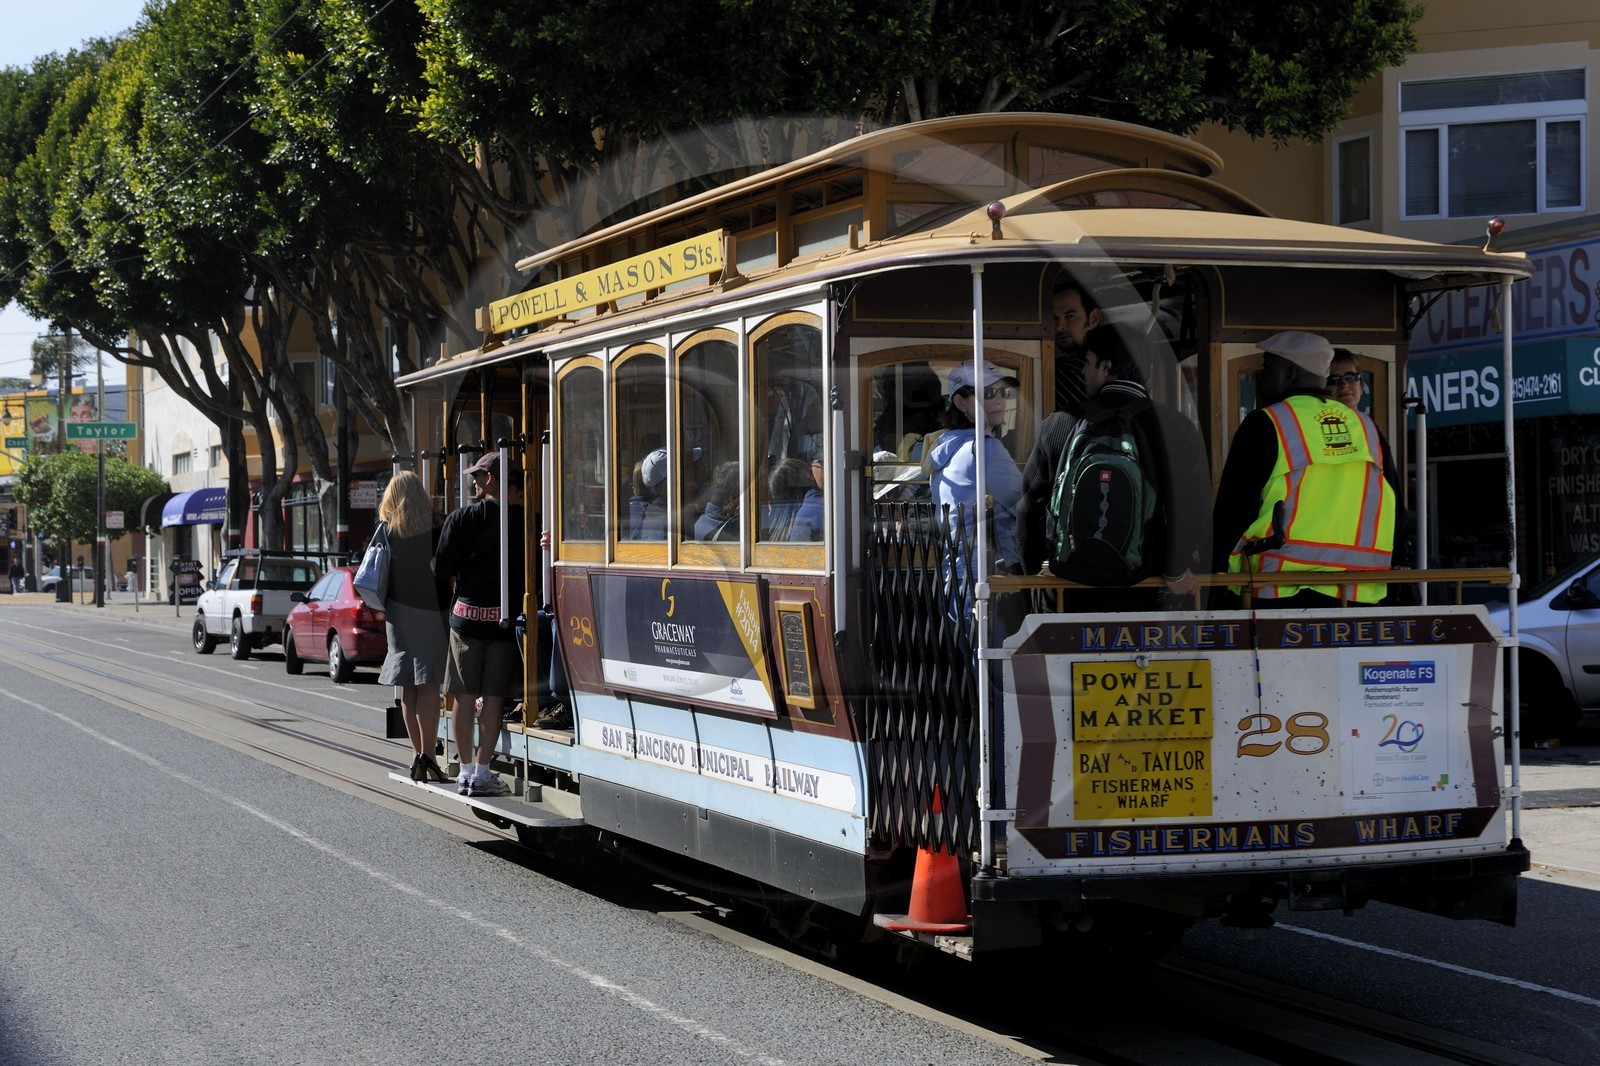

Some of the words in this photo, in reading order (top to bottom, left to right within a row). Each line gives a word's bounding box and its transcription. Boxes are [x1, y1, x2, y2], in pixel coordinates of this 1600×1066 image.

[498, 288, 567, 326] POWELL
[575, 281, 588, 304] &
[597, 253, 673, 297] MASON
[683, 243, 717, 272] Sts.
[76, 426, 126, 437] Taylor
[1323, 446, 1358, 457] DIVISION
[1561, 446, 1588, 466] DRY
[179, 587, 202, 596] OPEN
[570, 616, 594, 648] 28
[651, 621, 696, 644] GRACEWAY
[1081, 623, 1241, 651] MARKET
[1281, 619, 1416, 647] STREET
[655, 644, 697, 657] PHARMACEUTICALS
[1081, 671, 1203, 691] POWELL
[1364, 668, 1417, 683] Kogenate
[1418, 667, 1433, 679] FS
[1115, 692, 1174, 706] AND
[1080, 708, 1206, 728] MARKET
[602, 726, 623, 750] SAN
[1237, 711, 1330, 758] 28
[1080, 752, 1111, 774] BAY
[1117, 753, 1138, 773] AND
[1142, 750, 1205, 772] TAYLOR
[1091, 777, 1194, 794] FISHERMANS
[1117, 794, 1170, 809] WHARF
[1066, 822, 1316, 856] FISHERMANS
[1355, 812, 1462, 843] WHARF
